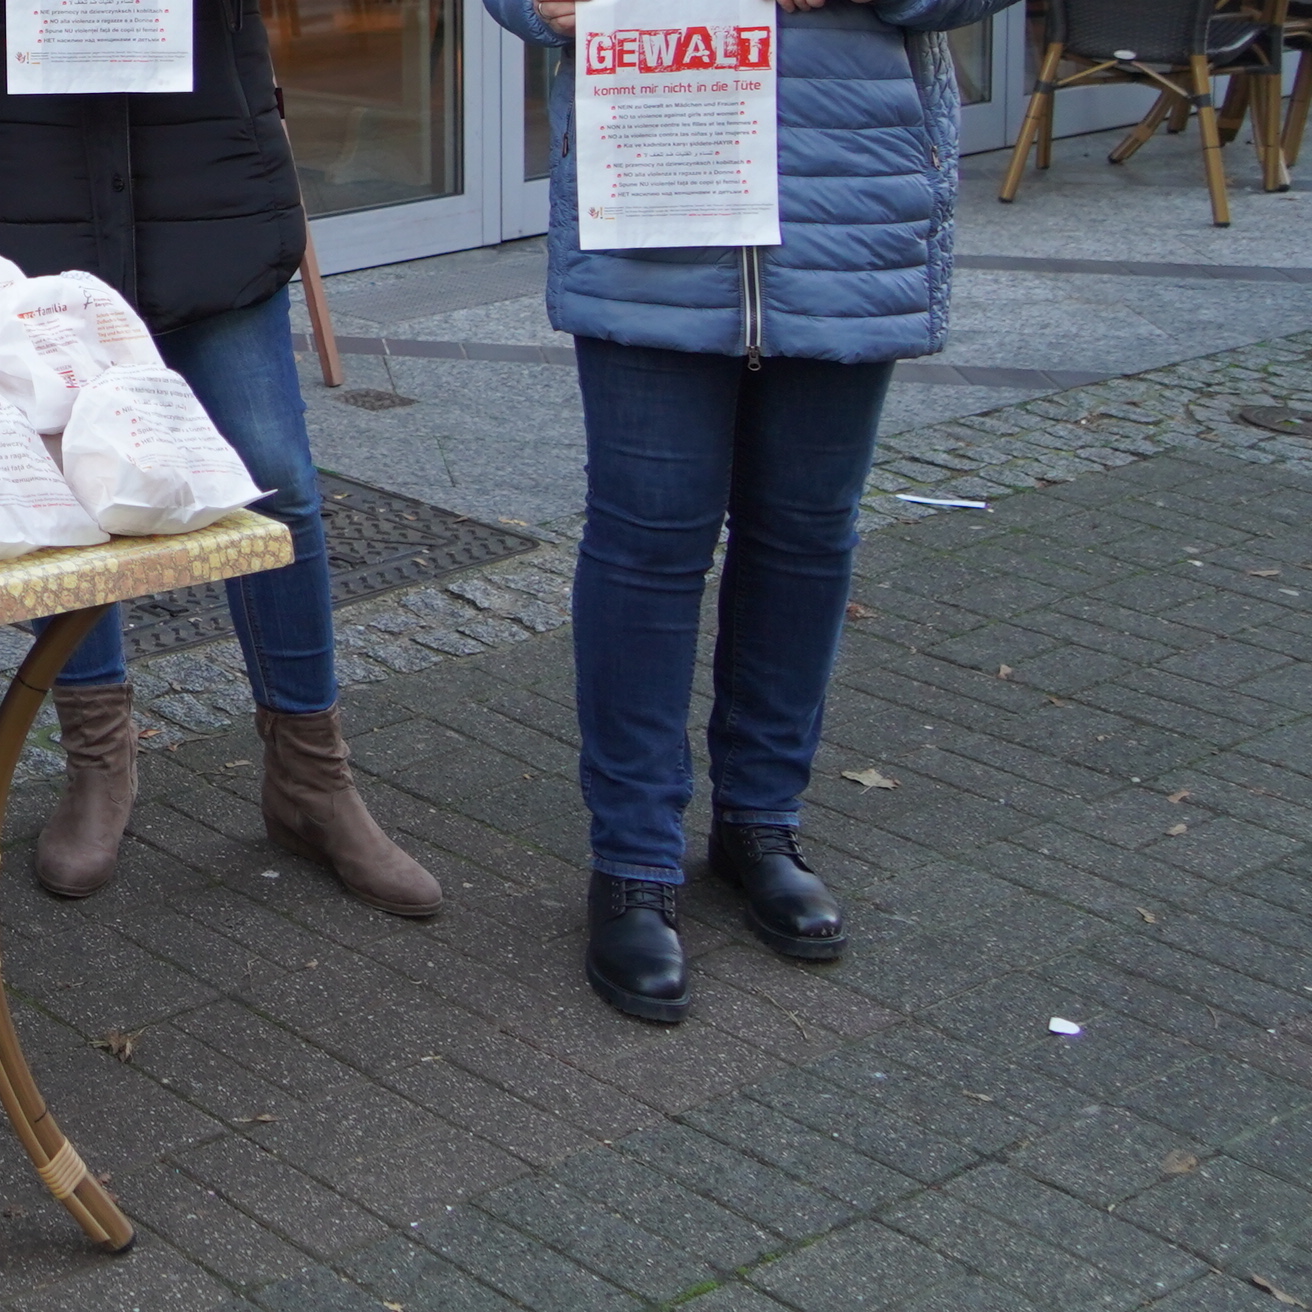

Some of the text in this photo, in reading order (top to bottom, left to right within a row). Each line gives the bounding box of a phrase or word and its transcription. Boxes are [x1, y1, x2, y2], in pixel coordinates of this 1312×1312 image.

[585, 25, 773, 76] GEWALT
[593, 79, 762, 97] kommt mir nicht in die Tüte
